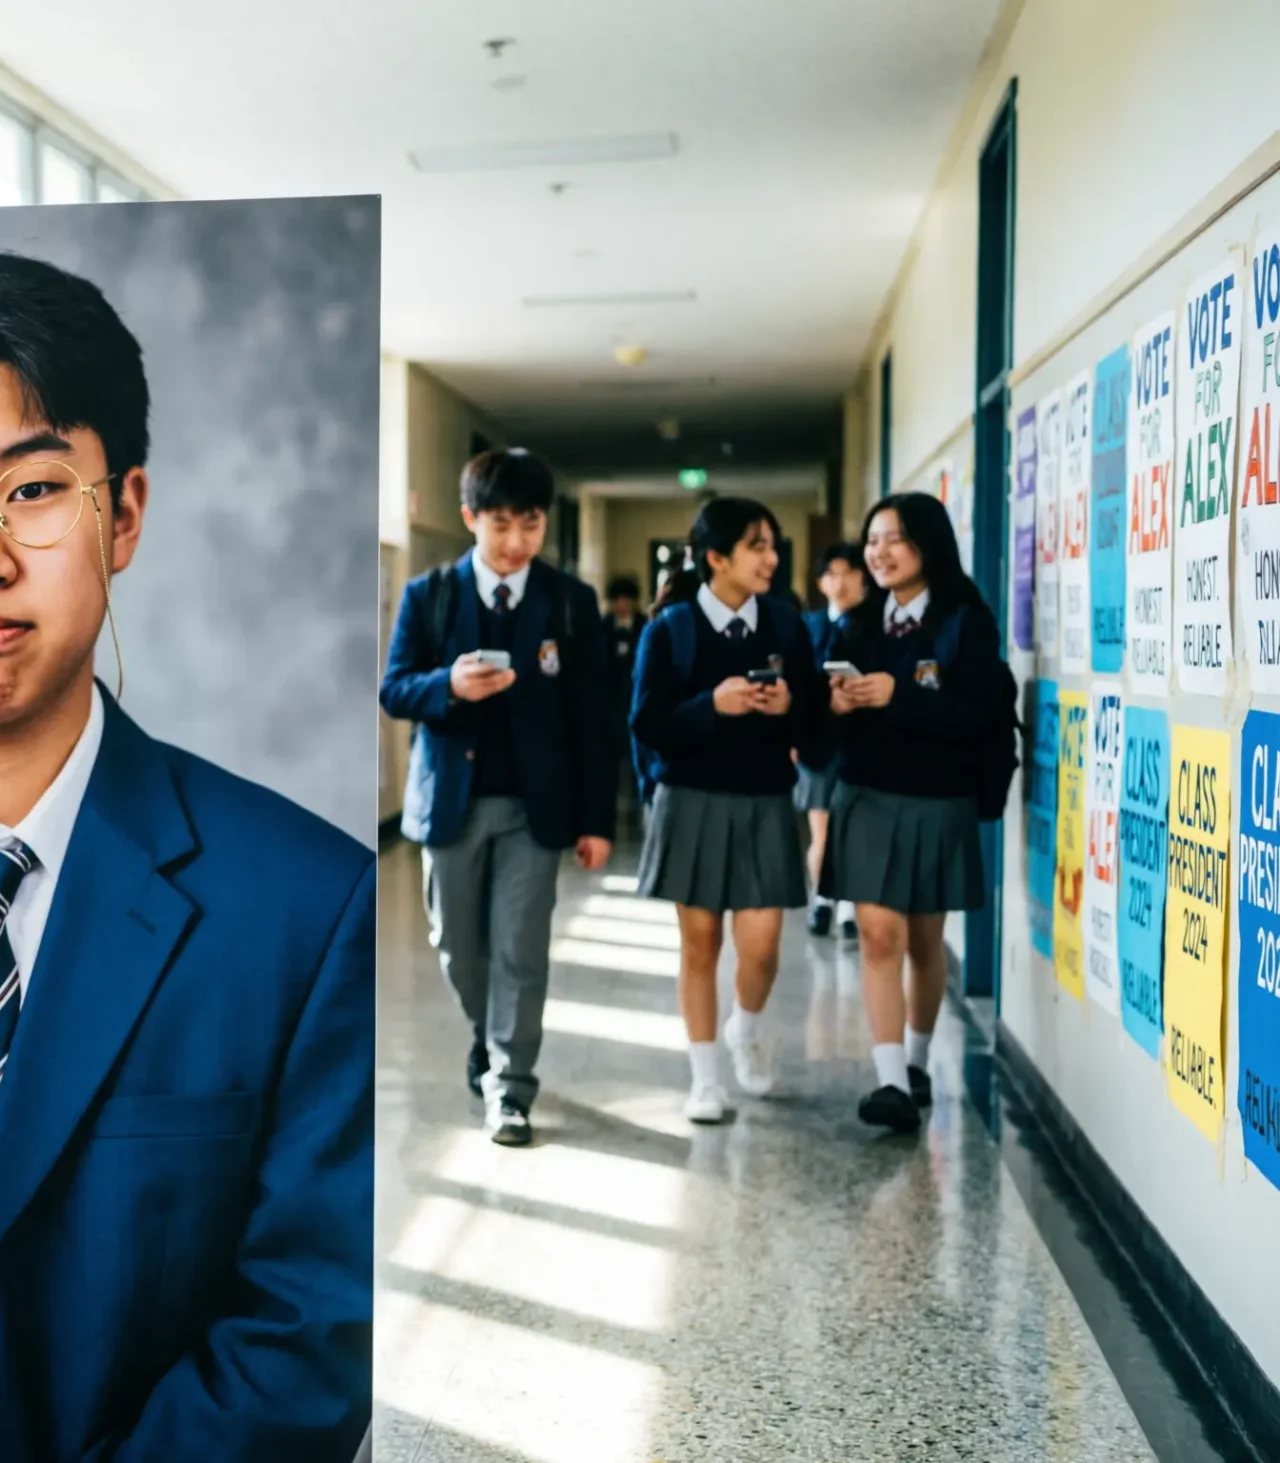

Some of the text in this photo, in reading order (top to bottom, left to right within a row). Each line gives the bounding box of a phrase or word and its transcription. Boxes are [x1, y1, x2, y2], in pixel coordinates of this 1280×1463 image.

[1188, 272, 1235, 370] VOTE
[1135, 325, 1171, 411] VOTE
[1194, 360, 1223, 426] FOR
[1180, 415, 1233, 529] ALEX
[1241, 402, 1280, 509] AL
[1129, 459, 1171, 555] ALEX
[1254, 549, 1280, 601] HON
[1125, 736, 1161, 810] CLASS
[1178, 759, 1218, 836] CLASS
[1169, 831, 1227, 913] PRESIDENT
[1239, 832, 1280, 915] PRESI
[1182, 908, 1208, 965] 2024
